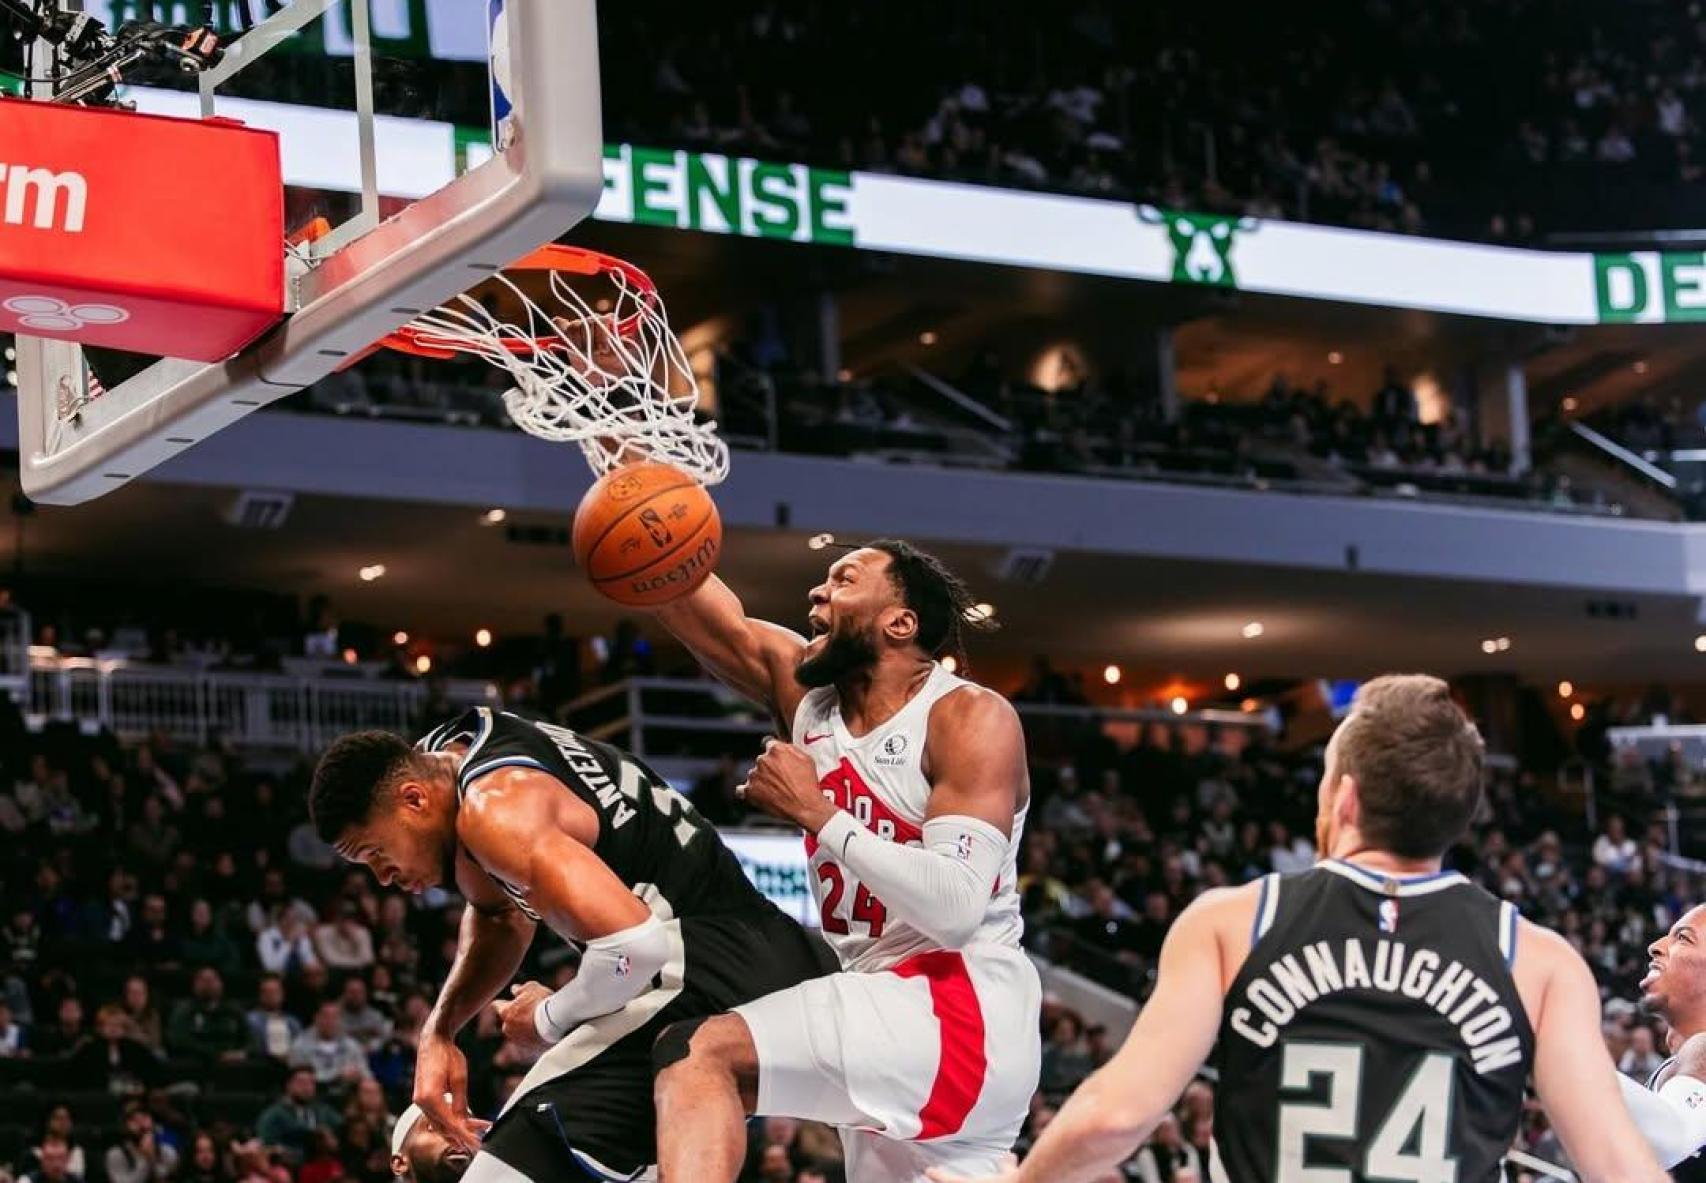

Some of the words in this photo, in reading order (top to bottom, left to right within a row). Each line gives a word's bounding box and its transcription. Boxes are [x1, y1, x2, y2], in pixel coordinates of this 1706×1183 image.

[817, 861, 887, 938] 24
[1230, 938, 1522, 1075] CONNAUGHTON
[1276, 1042, 1458, 1183] 24
